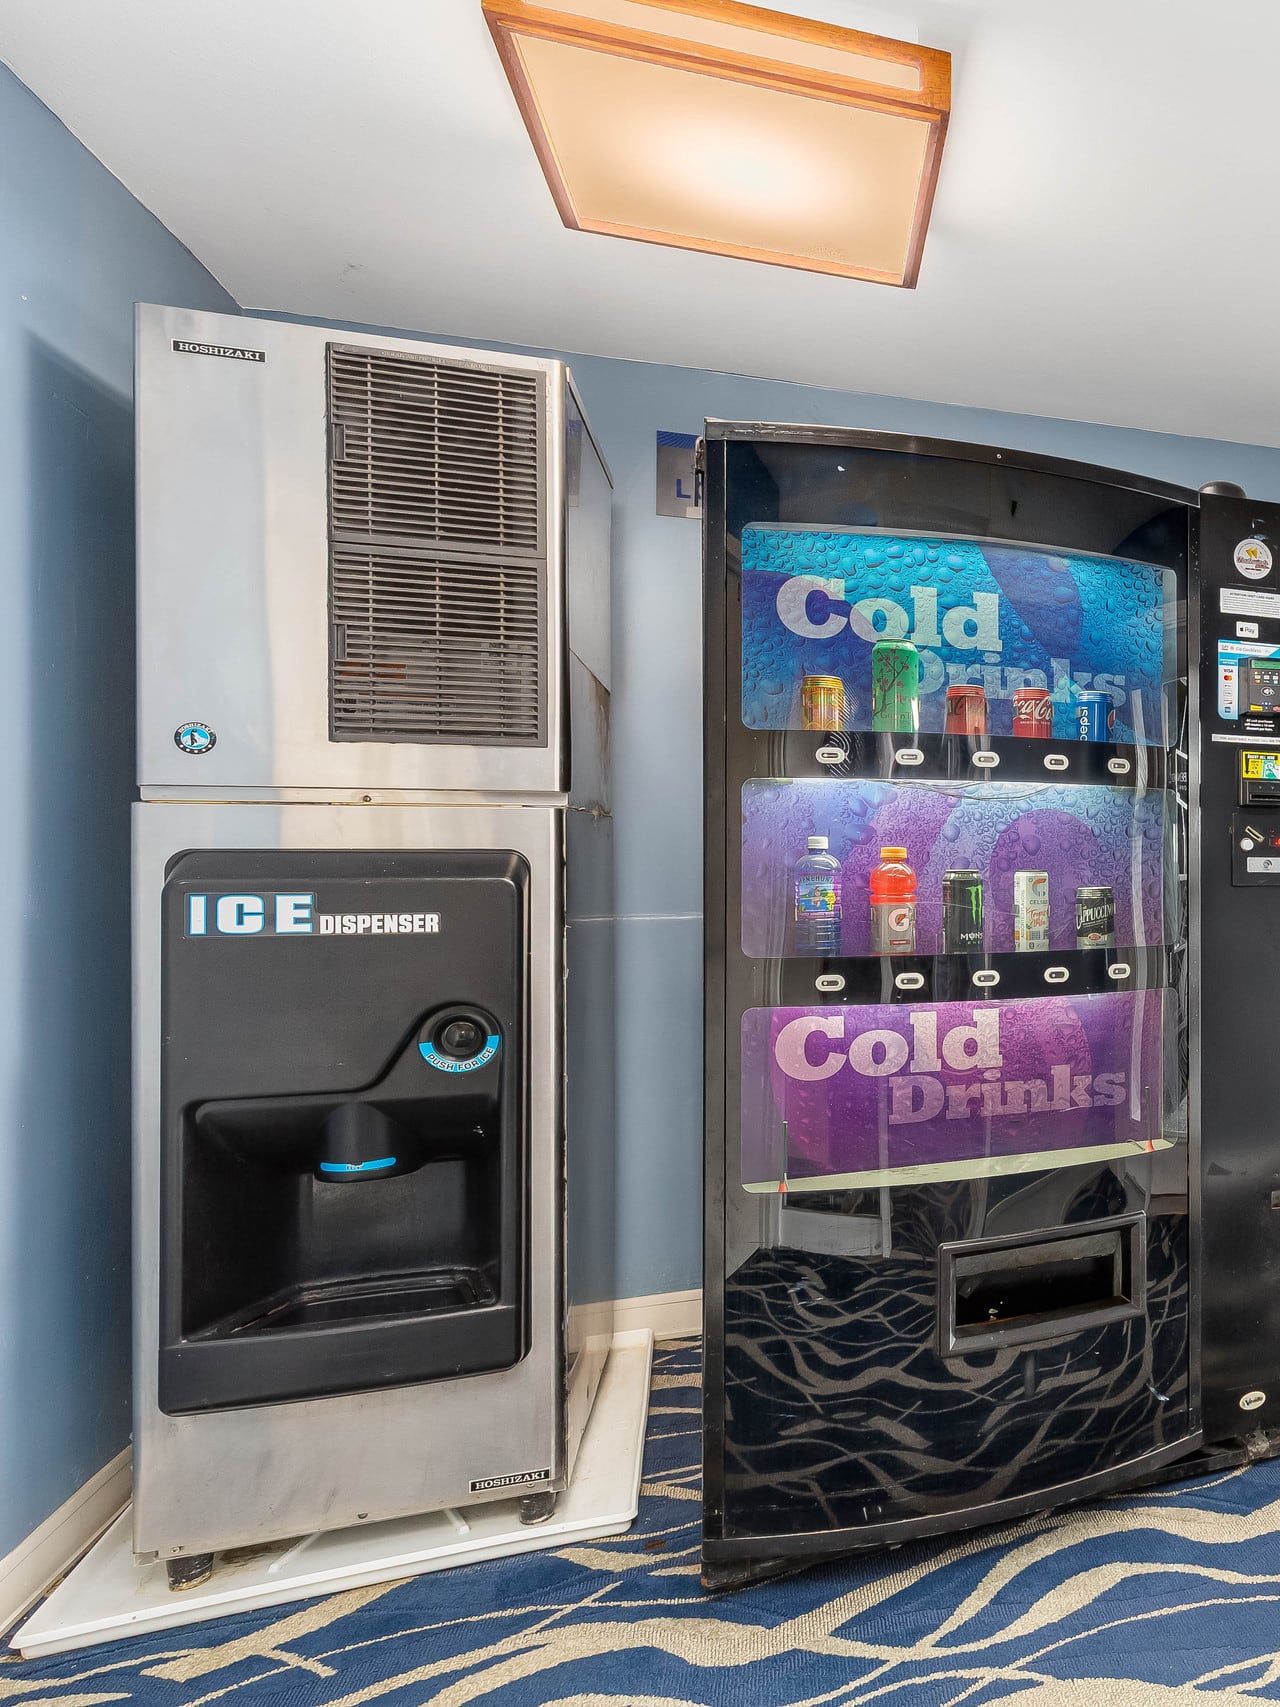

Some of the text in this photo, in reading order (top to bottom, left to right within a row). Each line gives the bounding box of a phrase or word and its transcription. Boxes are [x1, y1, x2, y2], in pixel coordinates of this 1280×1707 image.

[177, 342, 261, 361] HOSHIZAKI
[776, 574, 1003, 652] Cold
[189, 893, 440, 935] ICE DISPENSER
[888, 908, 909, 932] G
[427, 1047, 494, 1071] PUSH FOR ICE
[774, 1008, 1003, 1081] Cold
[888, 1064, 1127, 1125] Drinks
[475, 1471, 546, 1490] HOSHIZAKI
